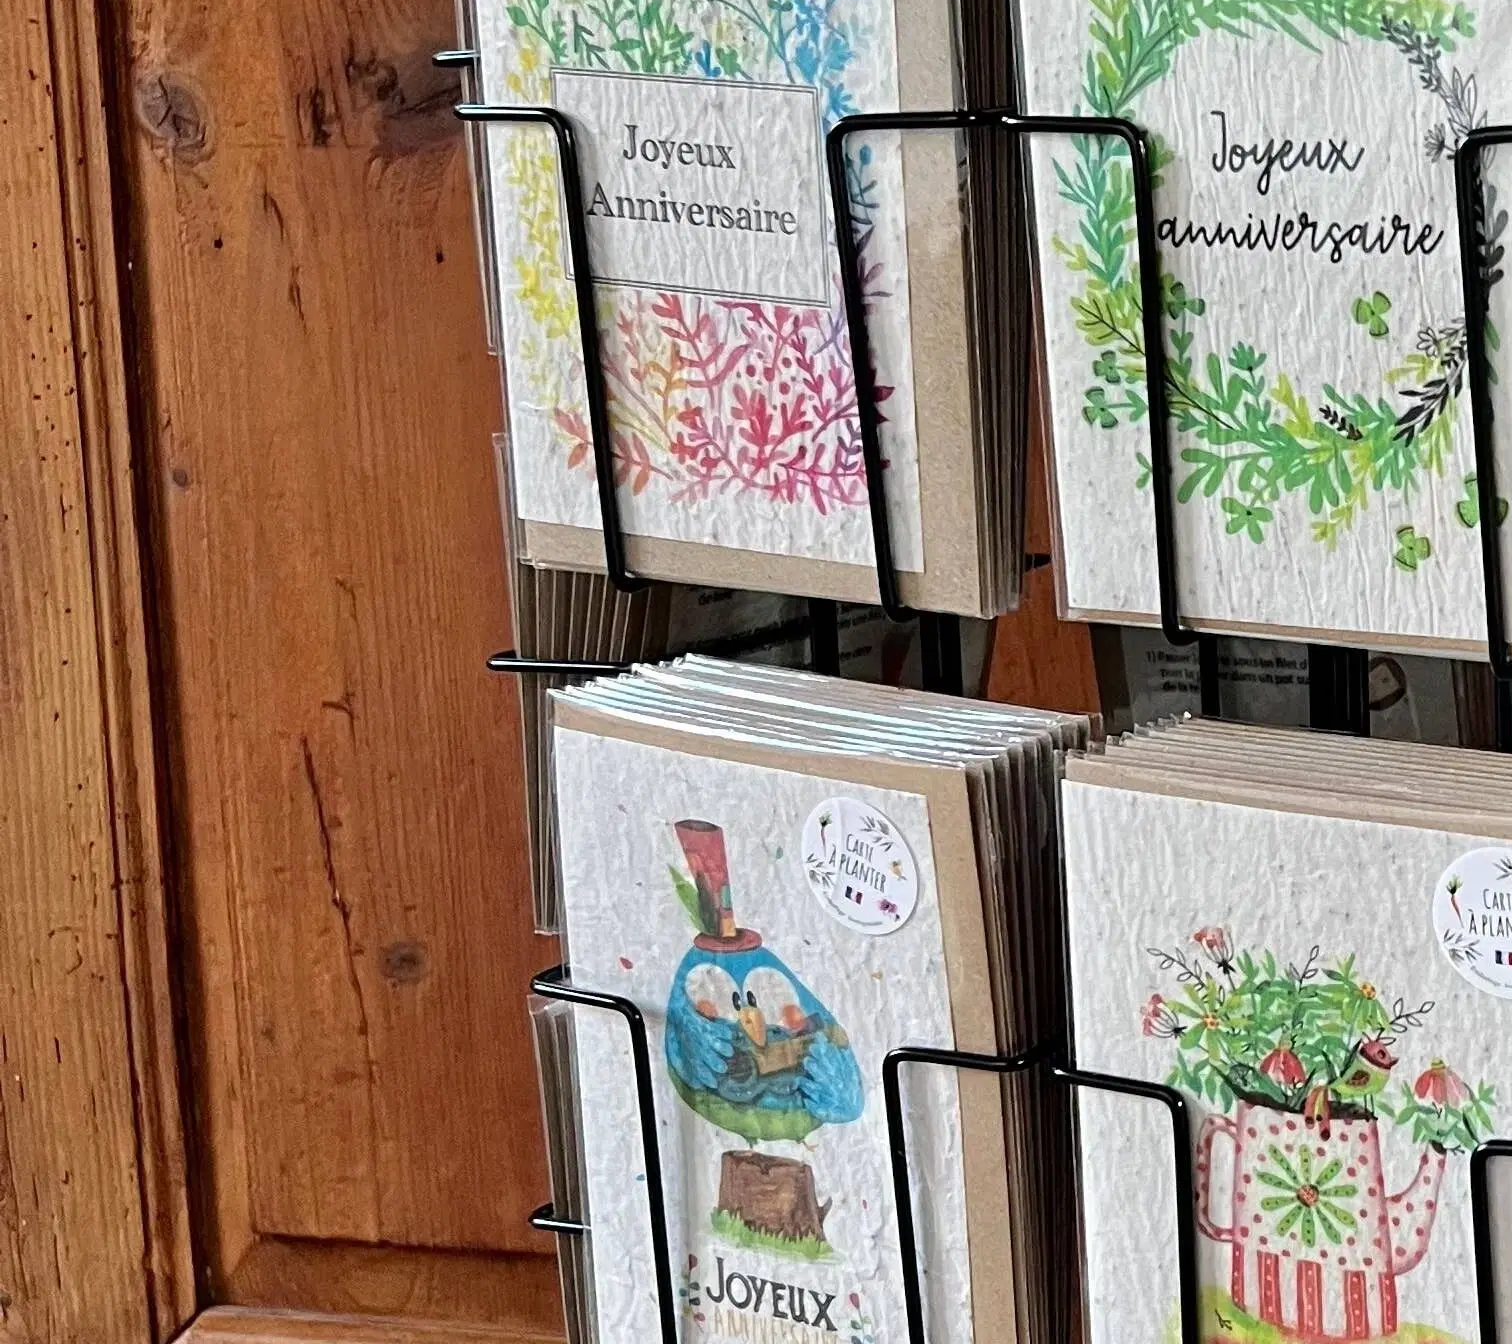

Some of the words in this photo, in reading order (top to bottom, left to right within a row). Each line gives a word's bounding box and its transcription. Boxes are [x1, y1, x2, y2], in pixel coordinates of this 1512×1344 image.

[622, 123, 737, 170] Joyeux
[1210, 109, 1365, 197] Joyeux
[585, 181, 798, 237] Anniversaire
[1157, 211, 1445, 265] anniversaire
[846, 833, 874, 863] CARTE
[839, 853, 887, 894] PLANTER
[1467, 908, 1478, 936] À
[705, 1255, 839, 1333] JOYEUX
